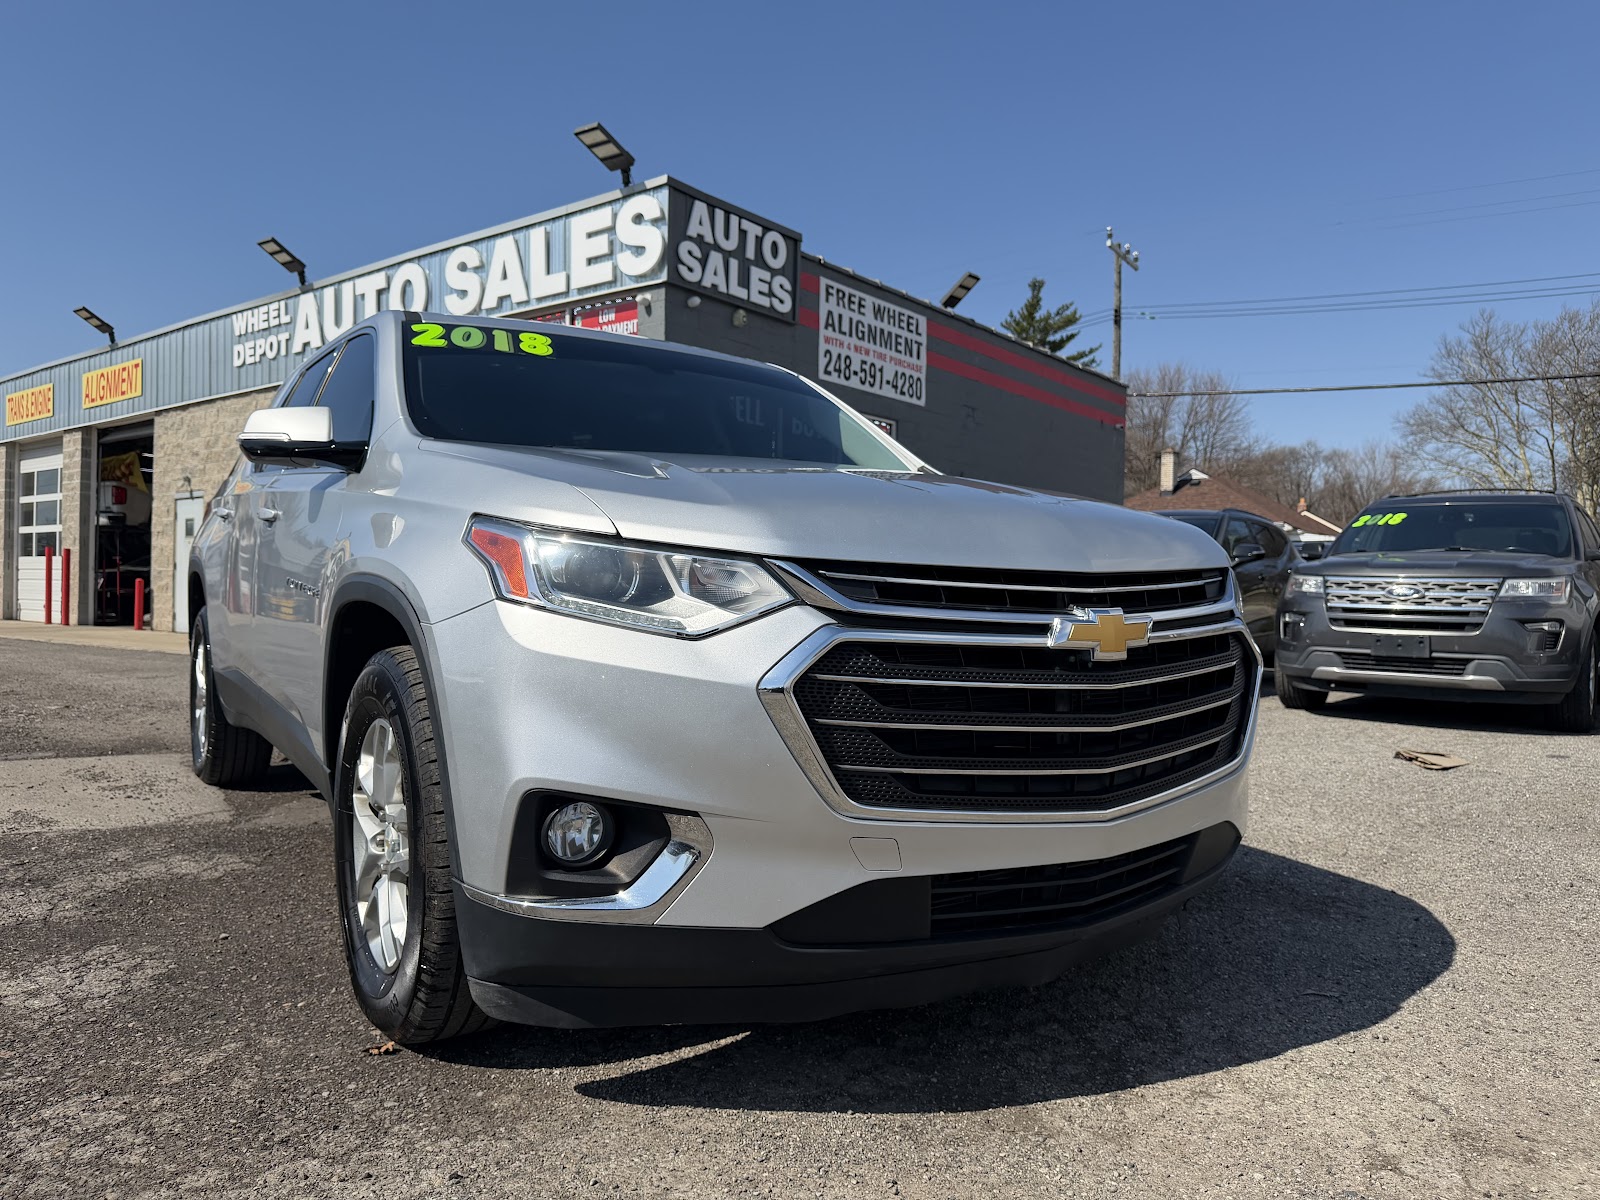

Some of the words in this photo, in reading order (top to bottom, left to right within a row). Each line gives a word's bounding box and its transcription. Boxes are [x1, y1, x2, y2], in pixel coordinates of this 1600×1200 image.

[686, 199, 788, 270] AUTO
[292, 263, 428, 354] AUTO
[444, 194, 665, 316] SALES
[677, 240, 793, 314] SALES
[232, 301, 292, 337] WHEEL
[598, 308, 616, 324] LOW
[825, 283, 867, 316] FREE
[872, 301, 922, 337] WHEEL
[232, 331, 291, 367] DEPOT
[410, 323, 553, 356] 2018
[823, 335, 845, 350] WITH
[853, 344, 870, 357] NEW
[872, 350, 887, 363] TIRE
[889, 356, 923, 374] PURCHASE
[824, 309, 923, 361] ALIGNMENT
[84, 362, 140, 405] ALIGNMENT
[823, 349, 923, 401] 248-591-4280
[8, 392, 25, 423] TRANS
[25, 393, 30, 418] &
[31, 386, 51, 418] ENGINE
[1351, 512, 1408, 528] 2018
